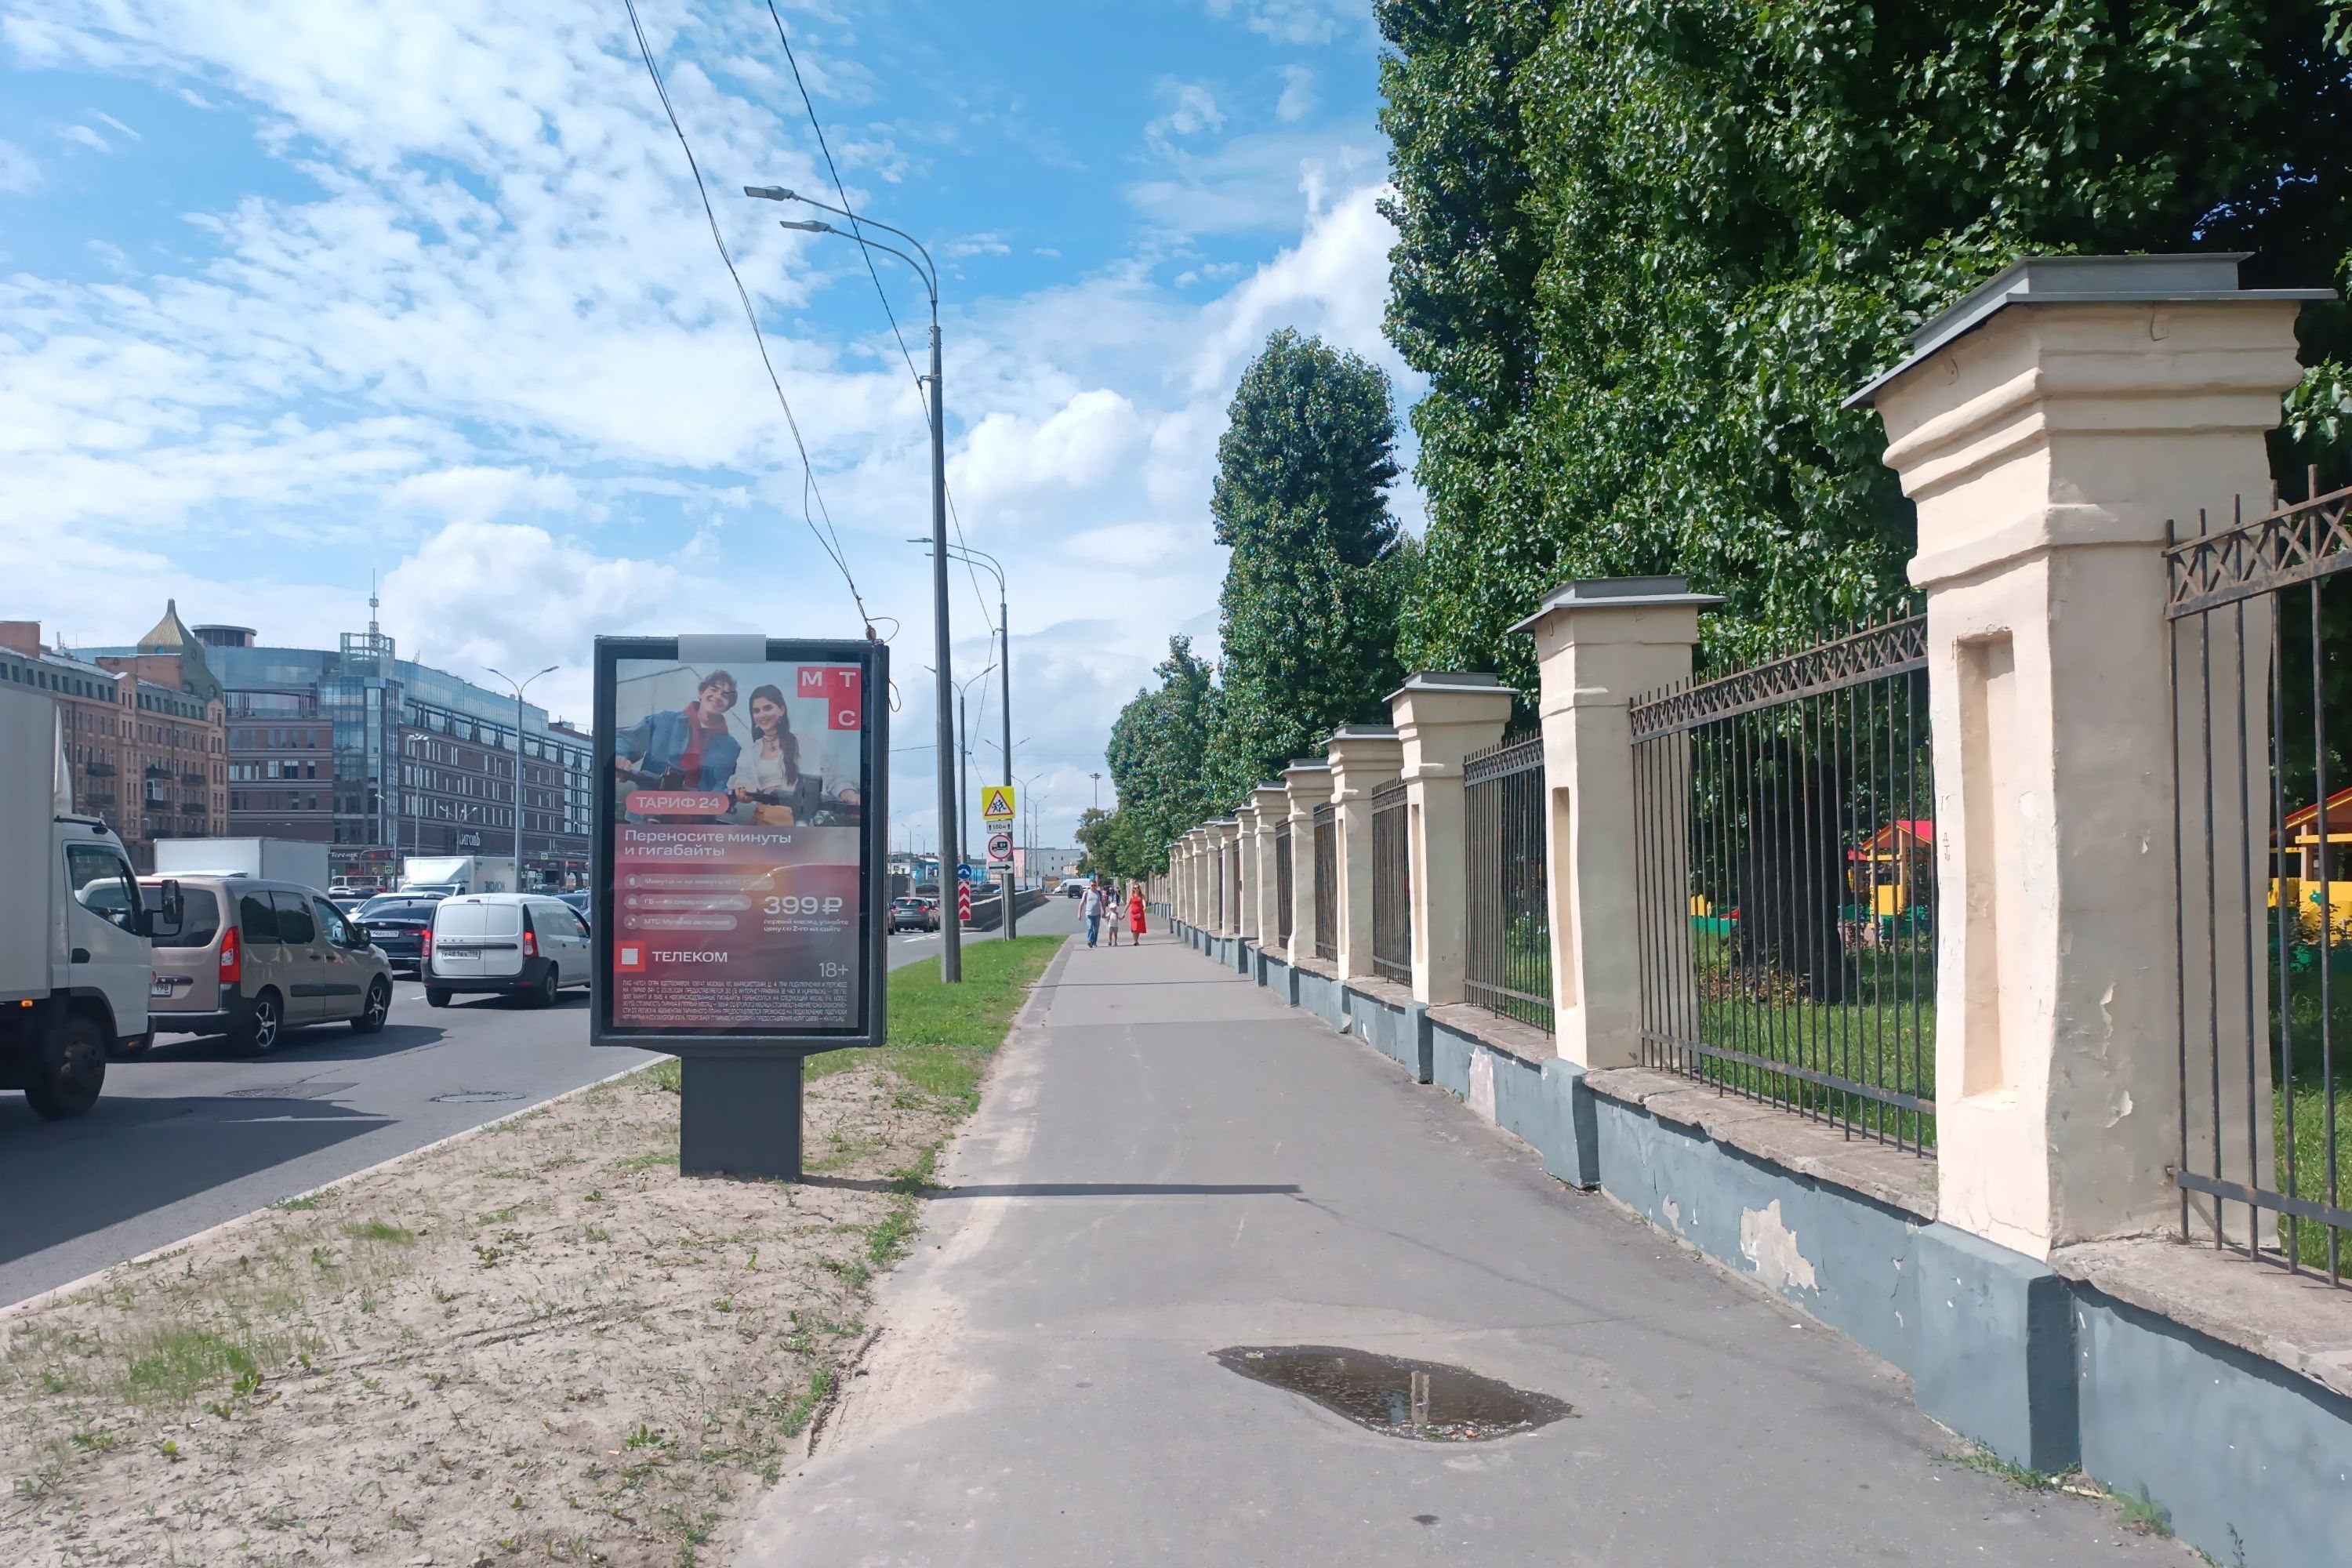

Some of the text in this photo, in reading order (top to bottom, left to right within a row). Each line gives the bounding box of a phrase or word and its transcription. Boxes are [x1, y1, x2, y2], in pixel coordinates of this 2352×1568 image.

[636, 797, 720, 808] ТАРИФ 24
[625, 829, 791, 845] Переносите минуты
[625, 844, 724, 856] и гигабайты
[652, 951, 728, 963] ТЕЛЕКОМ
[818, 962, 848, 977] 18+
